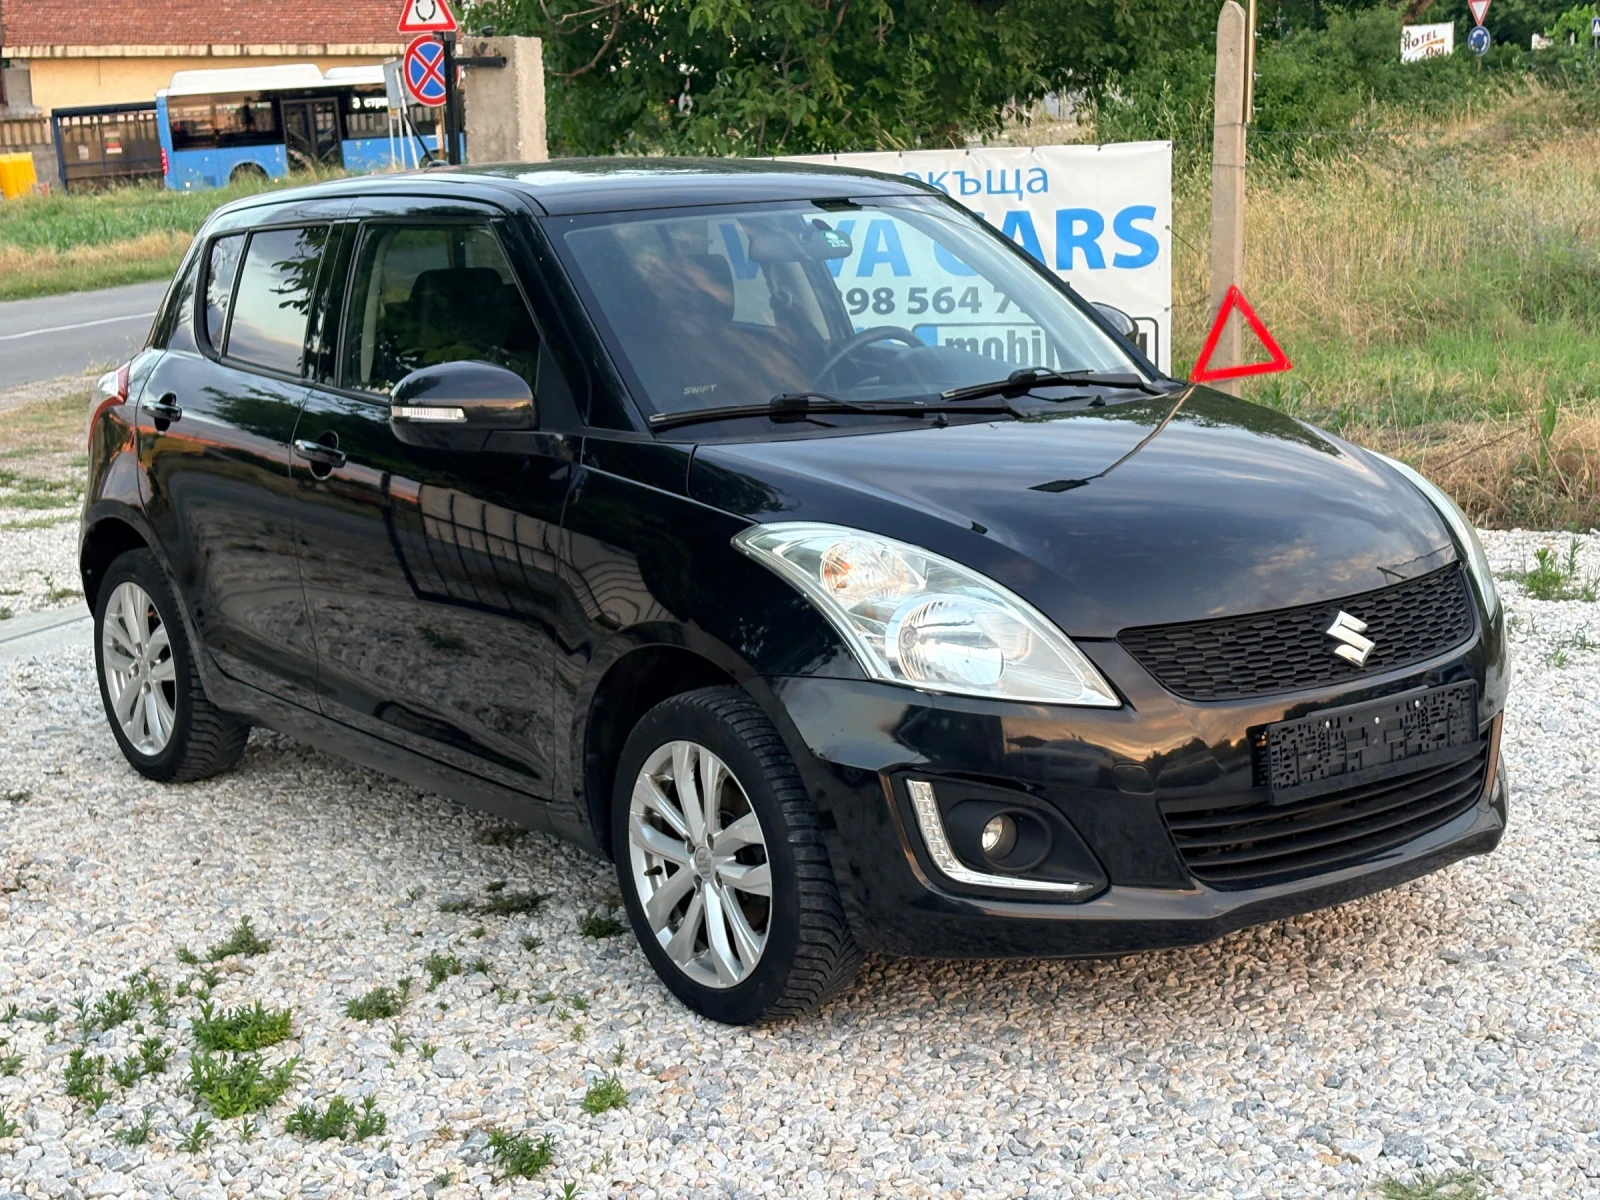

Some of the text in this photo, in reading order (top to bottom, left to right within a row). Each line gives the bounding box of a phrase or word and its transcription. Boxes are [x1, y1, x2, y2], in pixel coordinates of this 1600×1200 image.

[1404, 30, 1437, 51] HOTEL
[907, 286, 982, 315] 564
[683, 384, 717, 395] SWIFT
